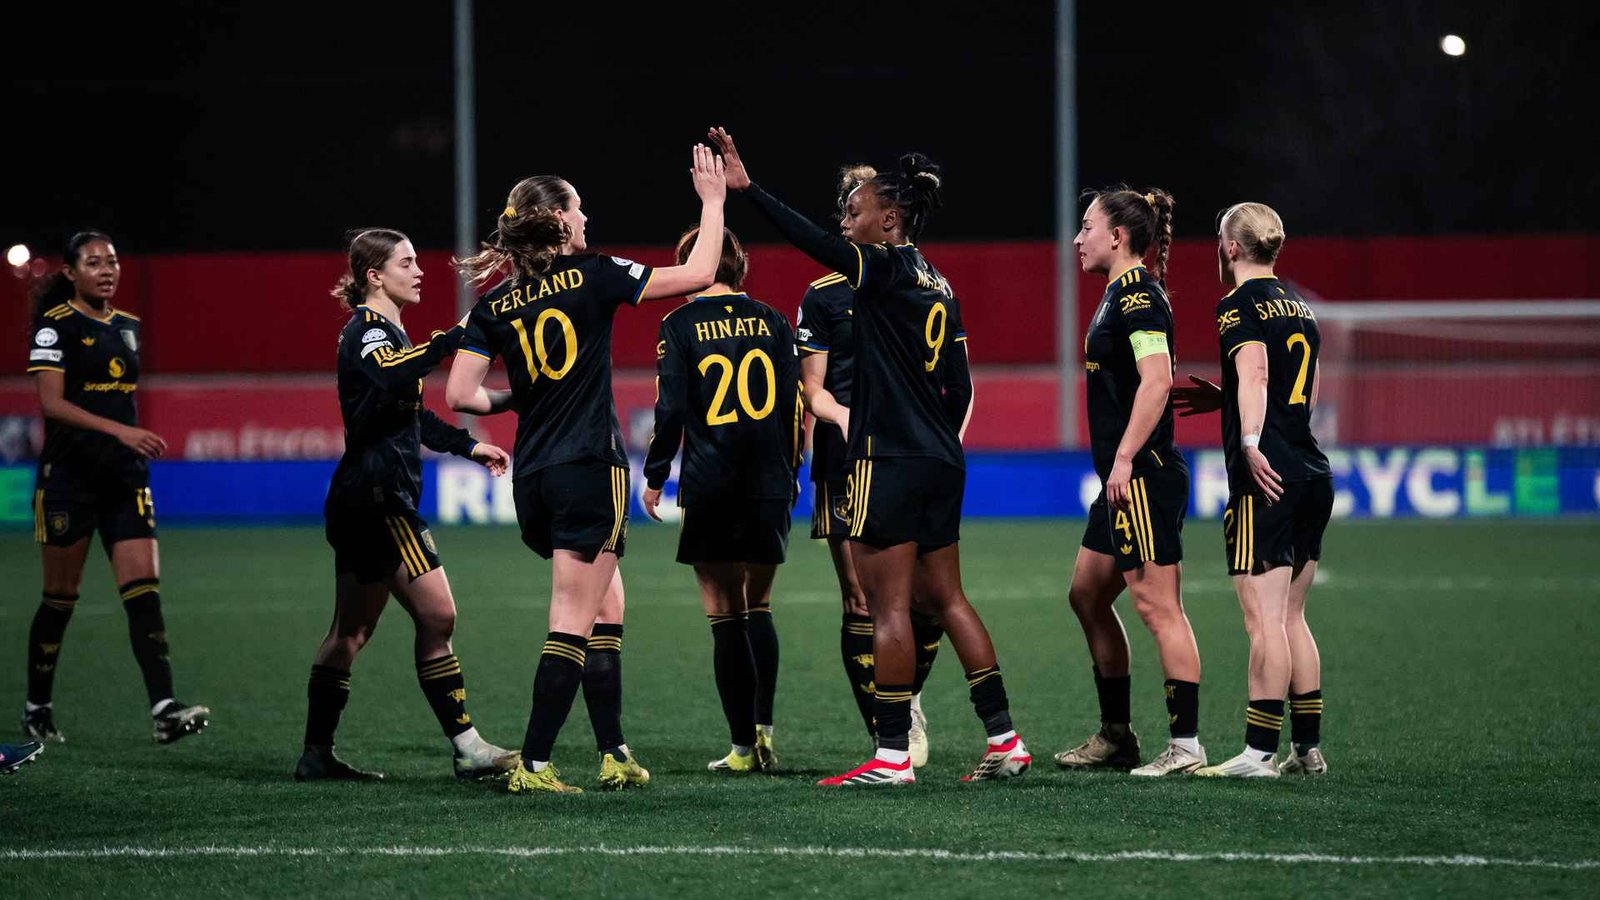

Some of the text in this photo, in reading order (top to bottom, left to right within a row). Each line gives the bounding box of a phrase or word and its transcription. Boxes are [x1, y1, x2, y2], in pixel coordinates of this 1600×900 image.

[488, 268, 584, 316] TERLAND
[1255, 299, 1316, 321] SANDBE
[510, 308, 578, 384] 10
[695, 318, 771, 342] HINATA
[925, 302, 947, 372] 9
[697, 348, 776, 426] 20
[1286, 333, 1311, 405] 2
[1115, 509, 1131, 540] 4
